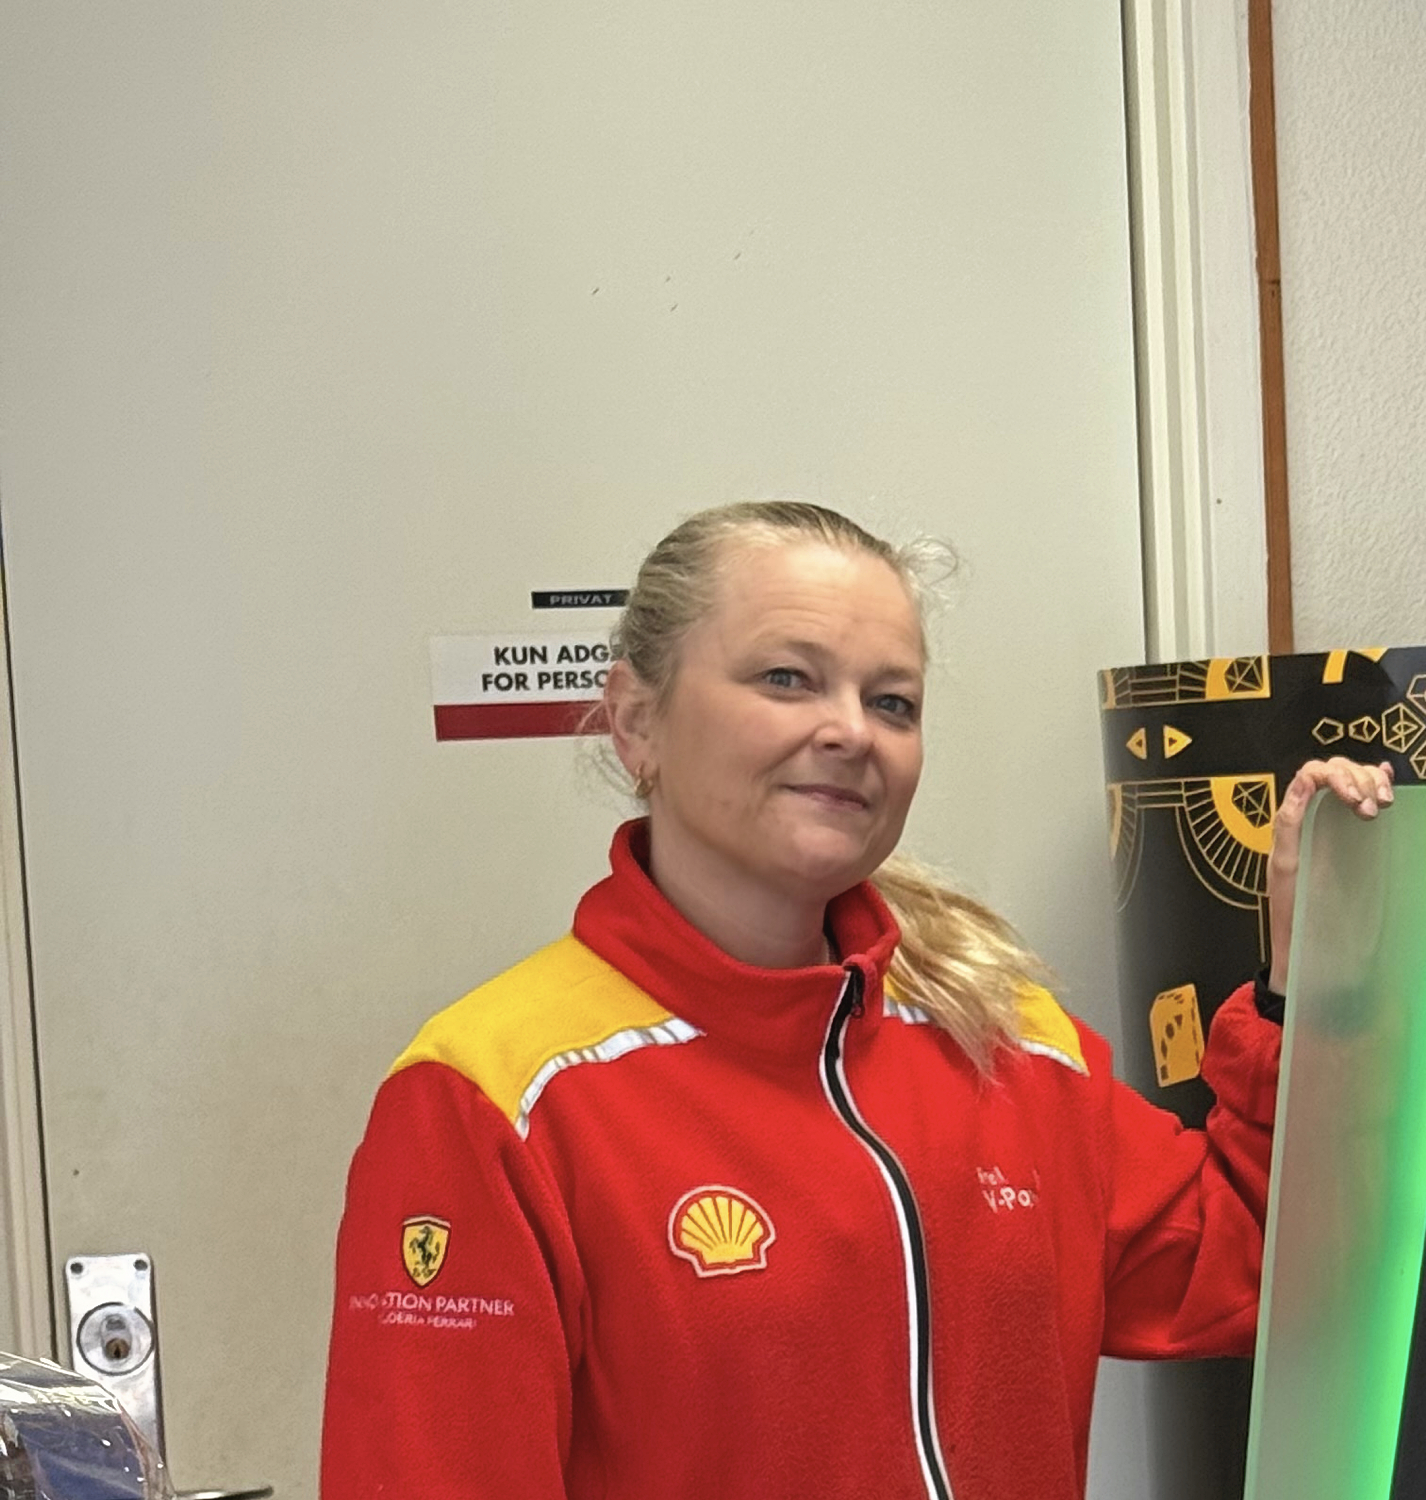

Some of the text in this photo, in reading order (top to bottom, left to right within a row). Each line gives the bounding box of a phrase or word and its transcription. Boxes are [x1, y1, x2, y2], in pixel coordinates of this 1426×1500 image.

[549, 593, 613, 606] PRIVAT
[493, 643, 610, 666] KUN ADG
[481, 671, 530, 692] FOR
[436, 1295, 515, 1316] PARTNER
